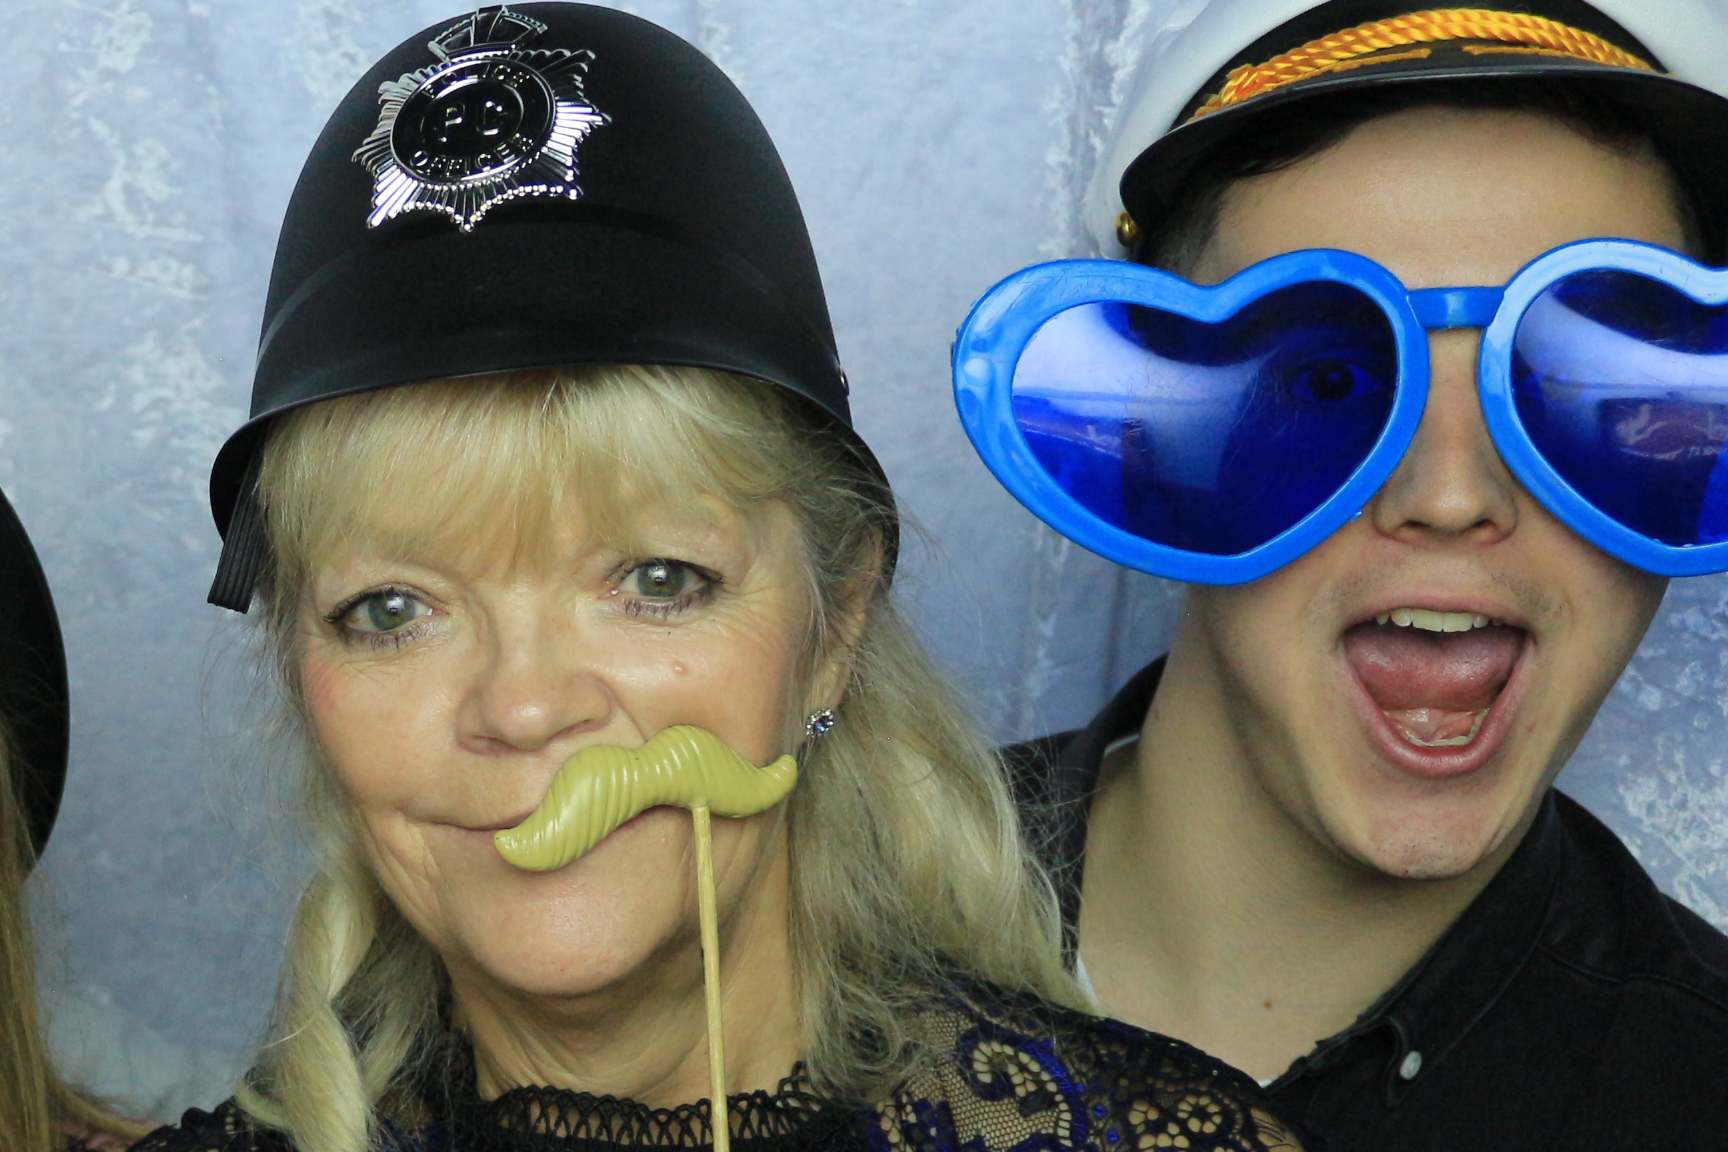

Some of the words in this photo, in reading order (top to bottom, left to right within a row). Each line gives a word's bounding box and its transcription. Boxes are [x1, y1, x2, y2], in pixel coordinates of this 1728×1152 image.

[422, 63, 531, 99] POLICE
[438, 99, 509, 143] PC
[410, 132, 534, 177] OFFICER
